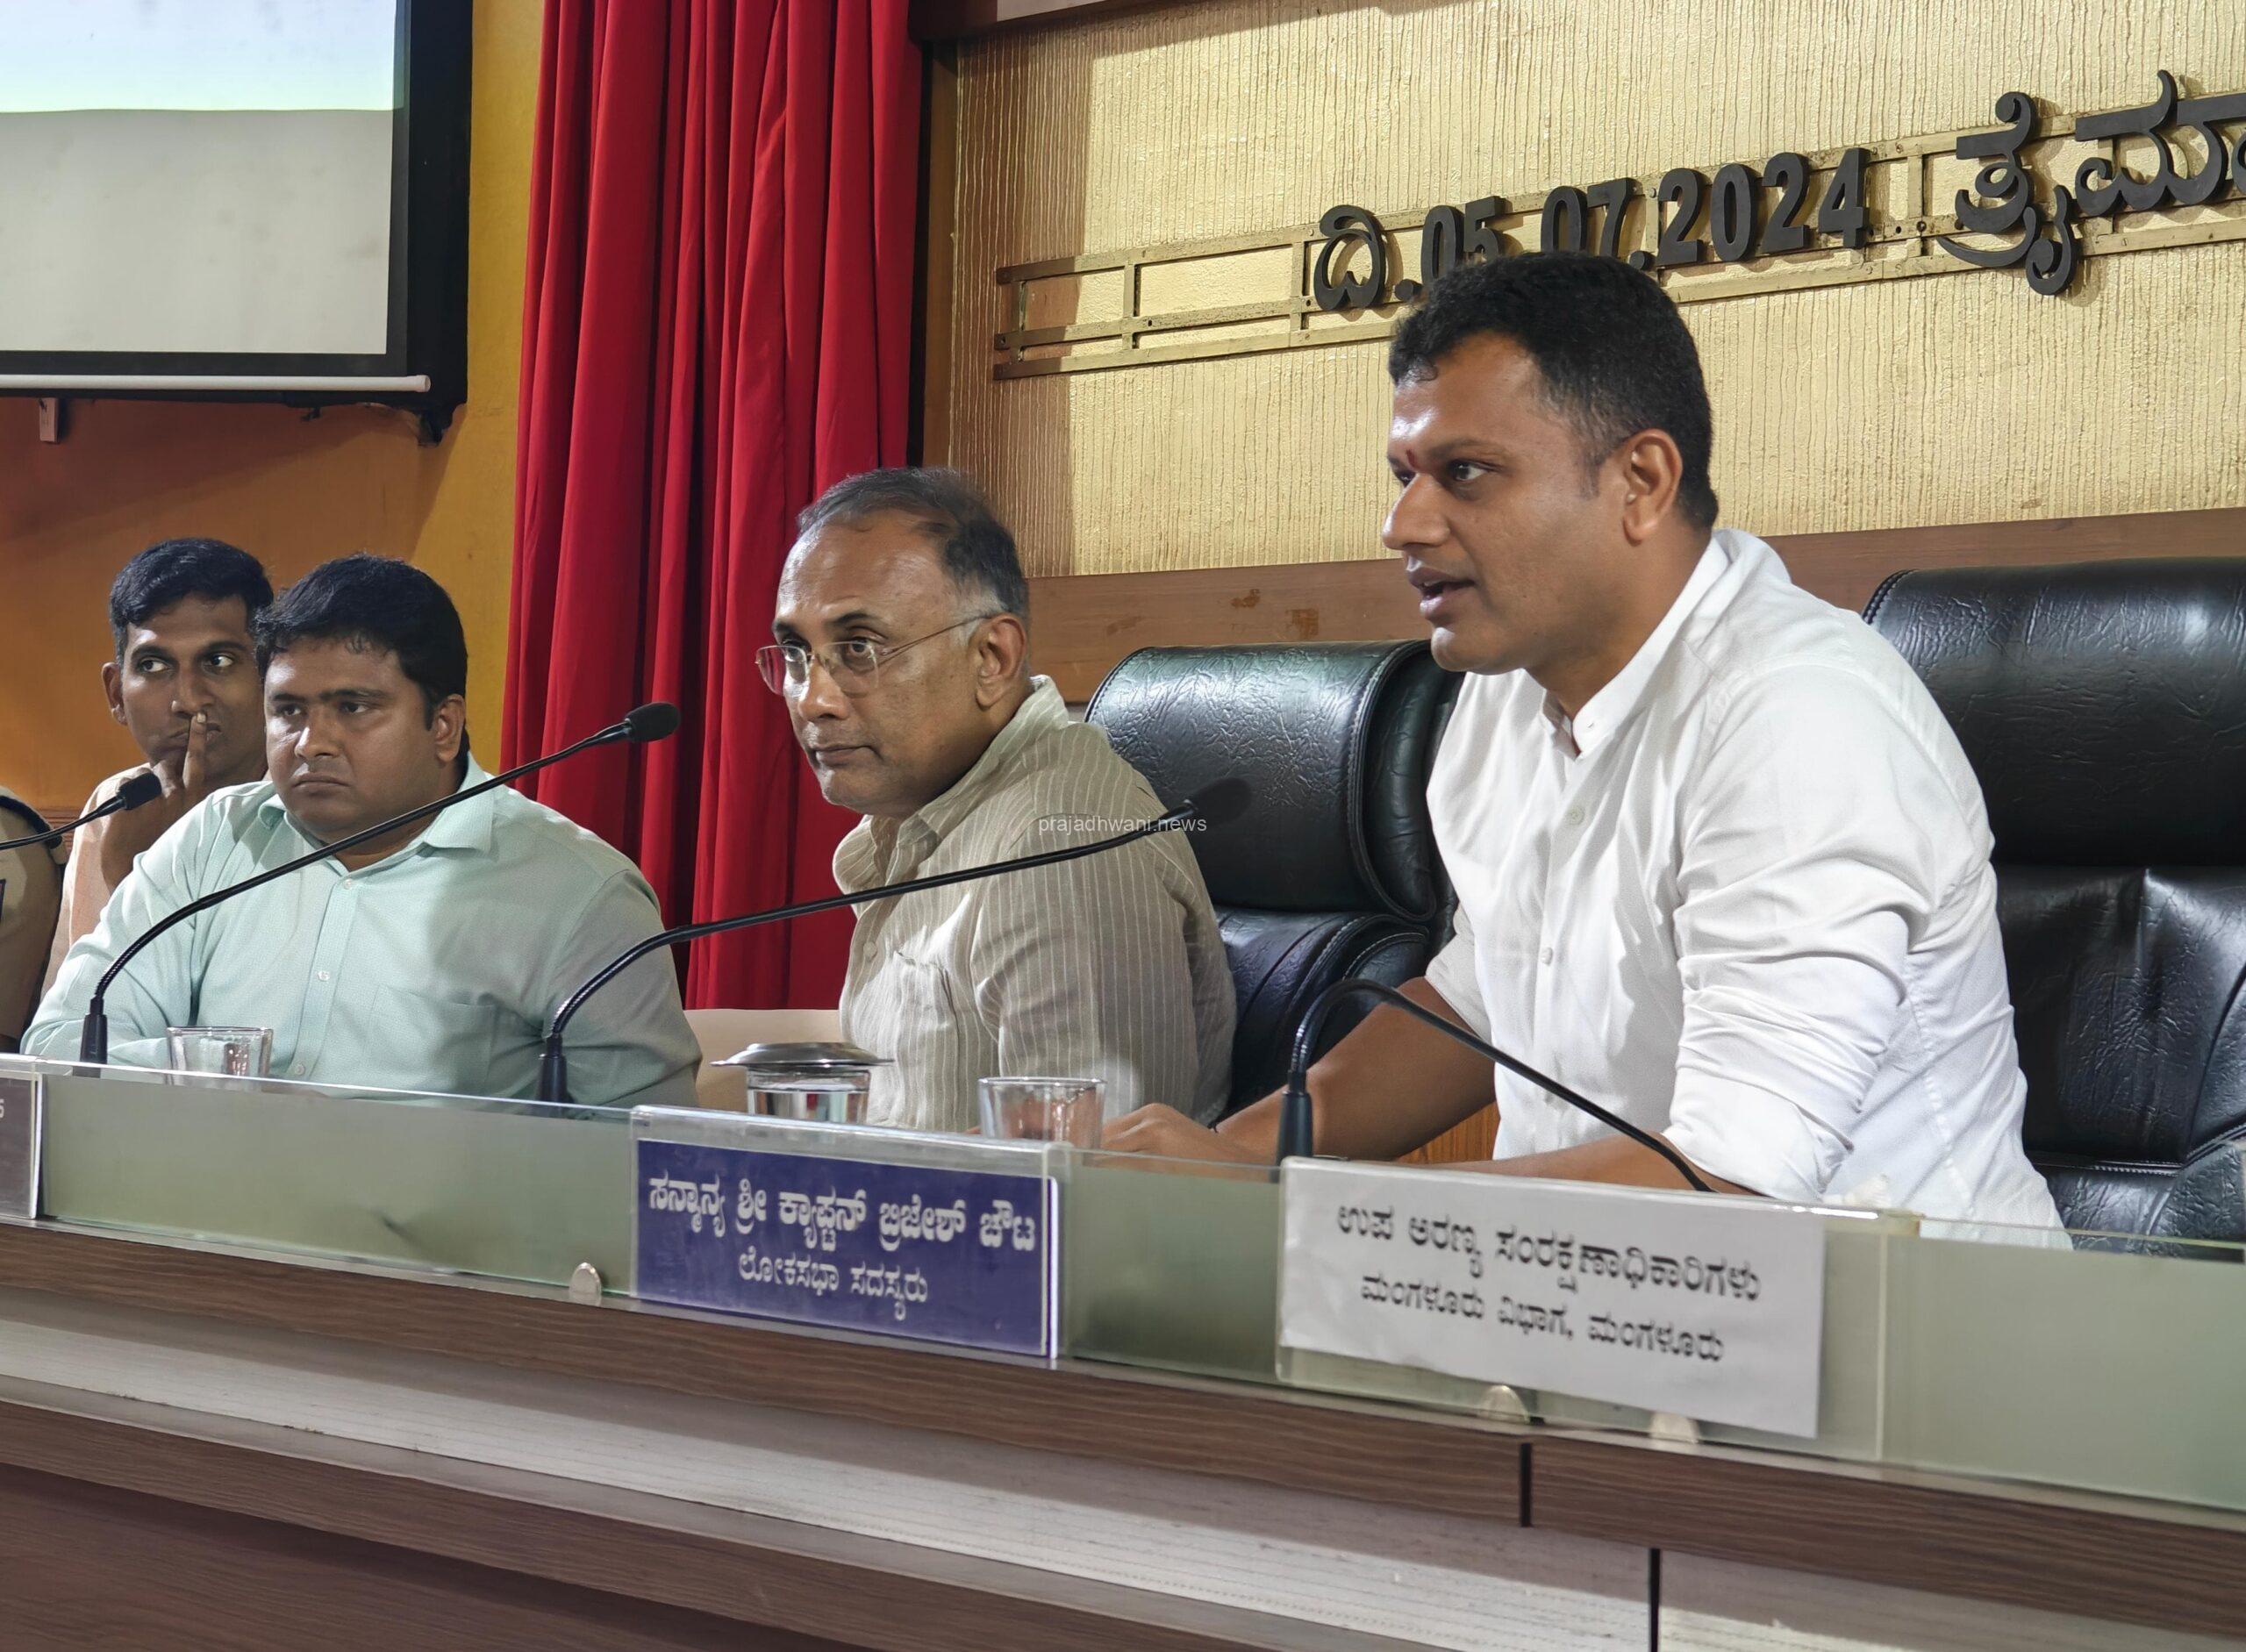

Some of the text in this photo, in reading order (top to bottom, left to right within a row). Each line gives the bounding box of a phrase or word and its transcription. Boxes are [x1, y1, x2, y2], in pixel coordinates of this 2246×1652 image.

[649, 1169, 726, 1238] ಸನ್ಮಾನ್ಯ
[736, 1178, 767, 1234] ಶ್ರೀ
[879, 1193, 966, 1251] ಬ್ರಿಜೇಶ್
[1338, 1205, 1394, 1240] ಉಪ
[1408, 1214, 1483, 1277] ಅರಣ್ಯ
[739, 1246, 928, 1320] ಲೋಕಸಭಾ ಸದಸ್ಯರು
[1363, 1273, 1483, 1319] ಮಂಗಳೂರು
[1589, 1312, 1725, 1362] ಮಂಗಳೂರು
